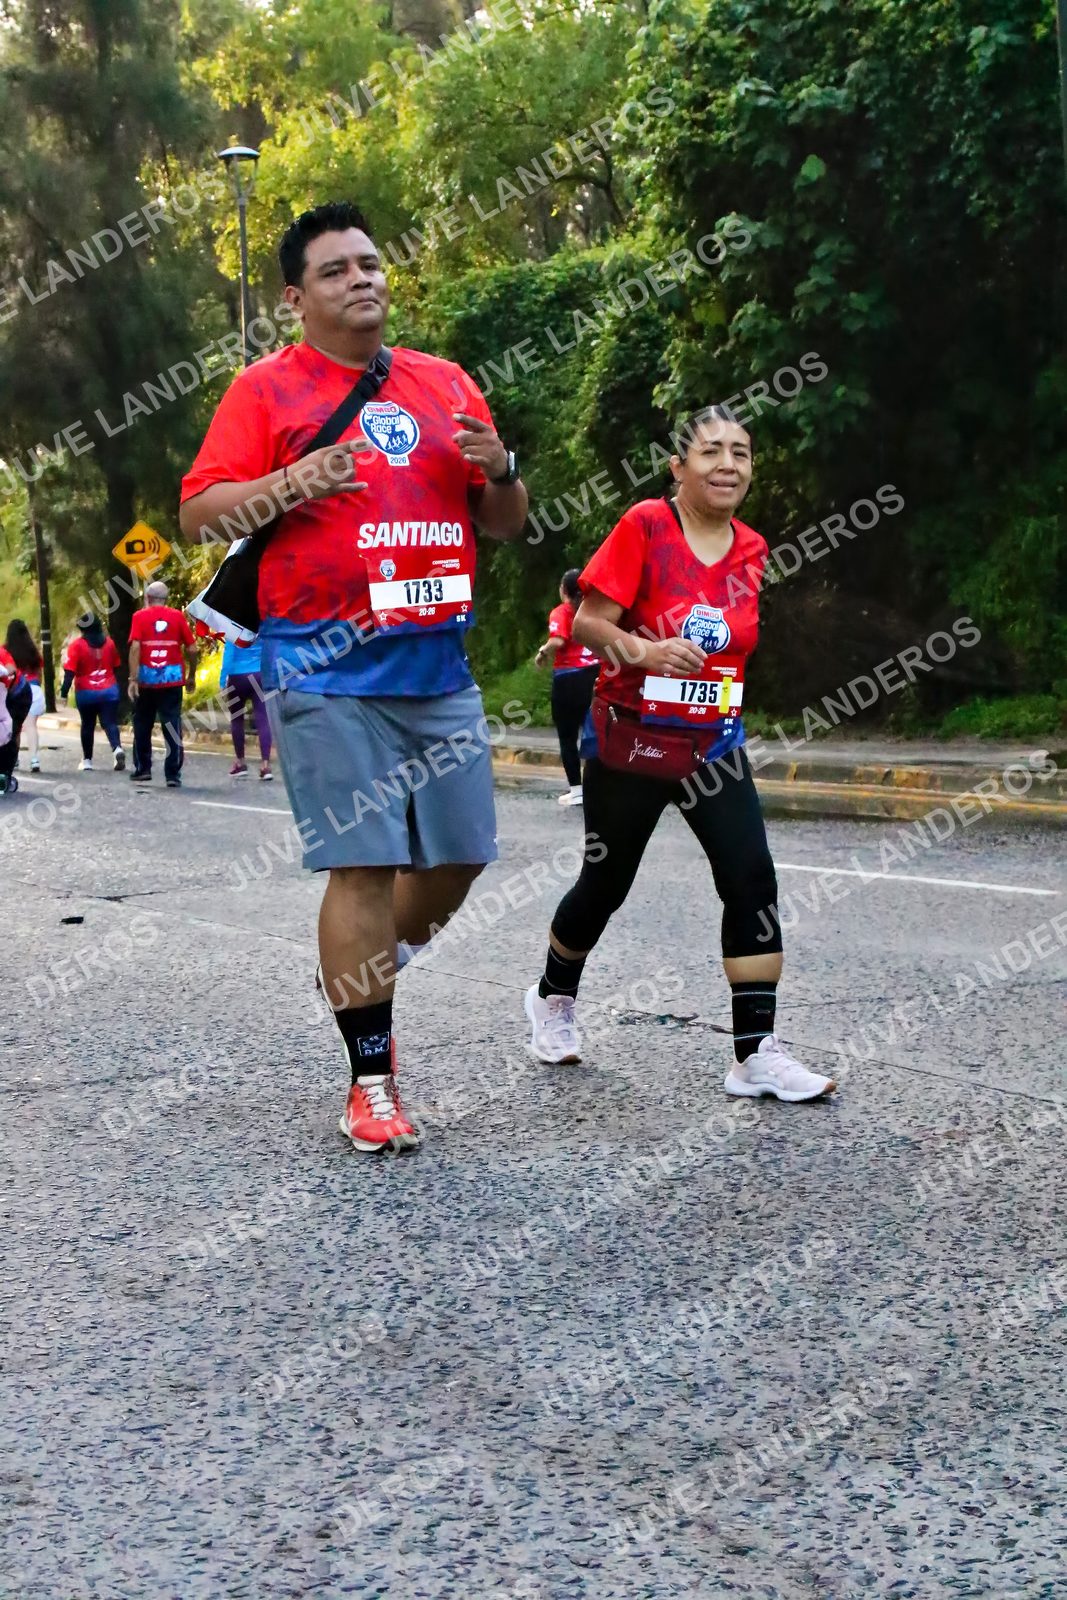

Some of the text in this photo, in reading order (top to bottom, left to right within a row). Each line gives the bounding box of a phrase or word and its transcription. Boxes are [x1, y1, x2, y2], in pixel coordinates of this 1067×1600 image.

[372, 414, 401, 427] Global
[370, 424, 393, 434] Race
[389, 456, 407, 464] 2026
[357, 521, 464, 549] SANTIAGO
[403, 578, 444, 605] 1733
[696, 619, 720, 631] Global
[690, 626, 711, 637] Race
[680, 681, 719, 704] 1735
